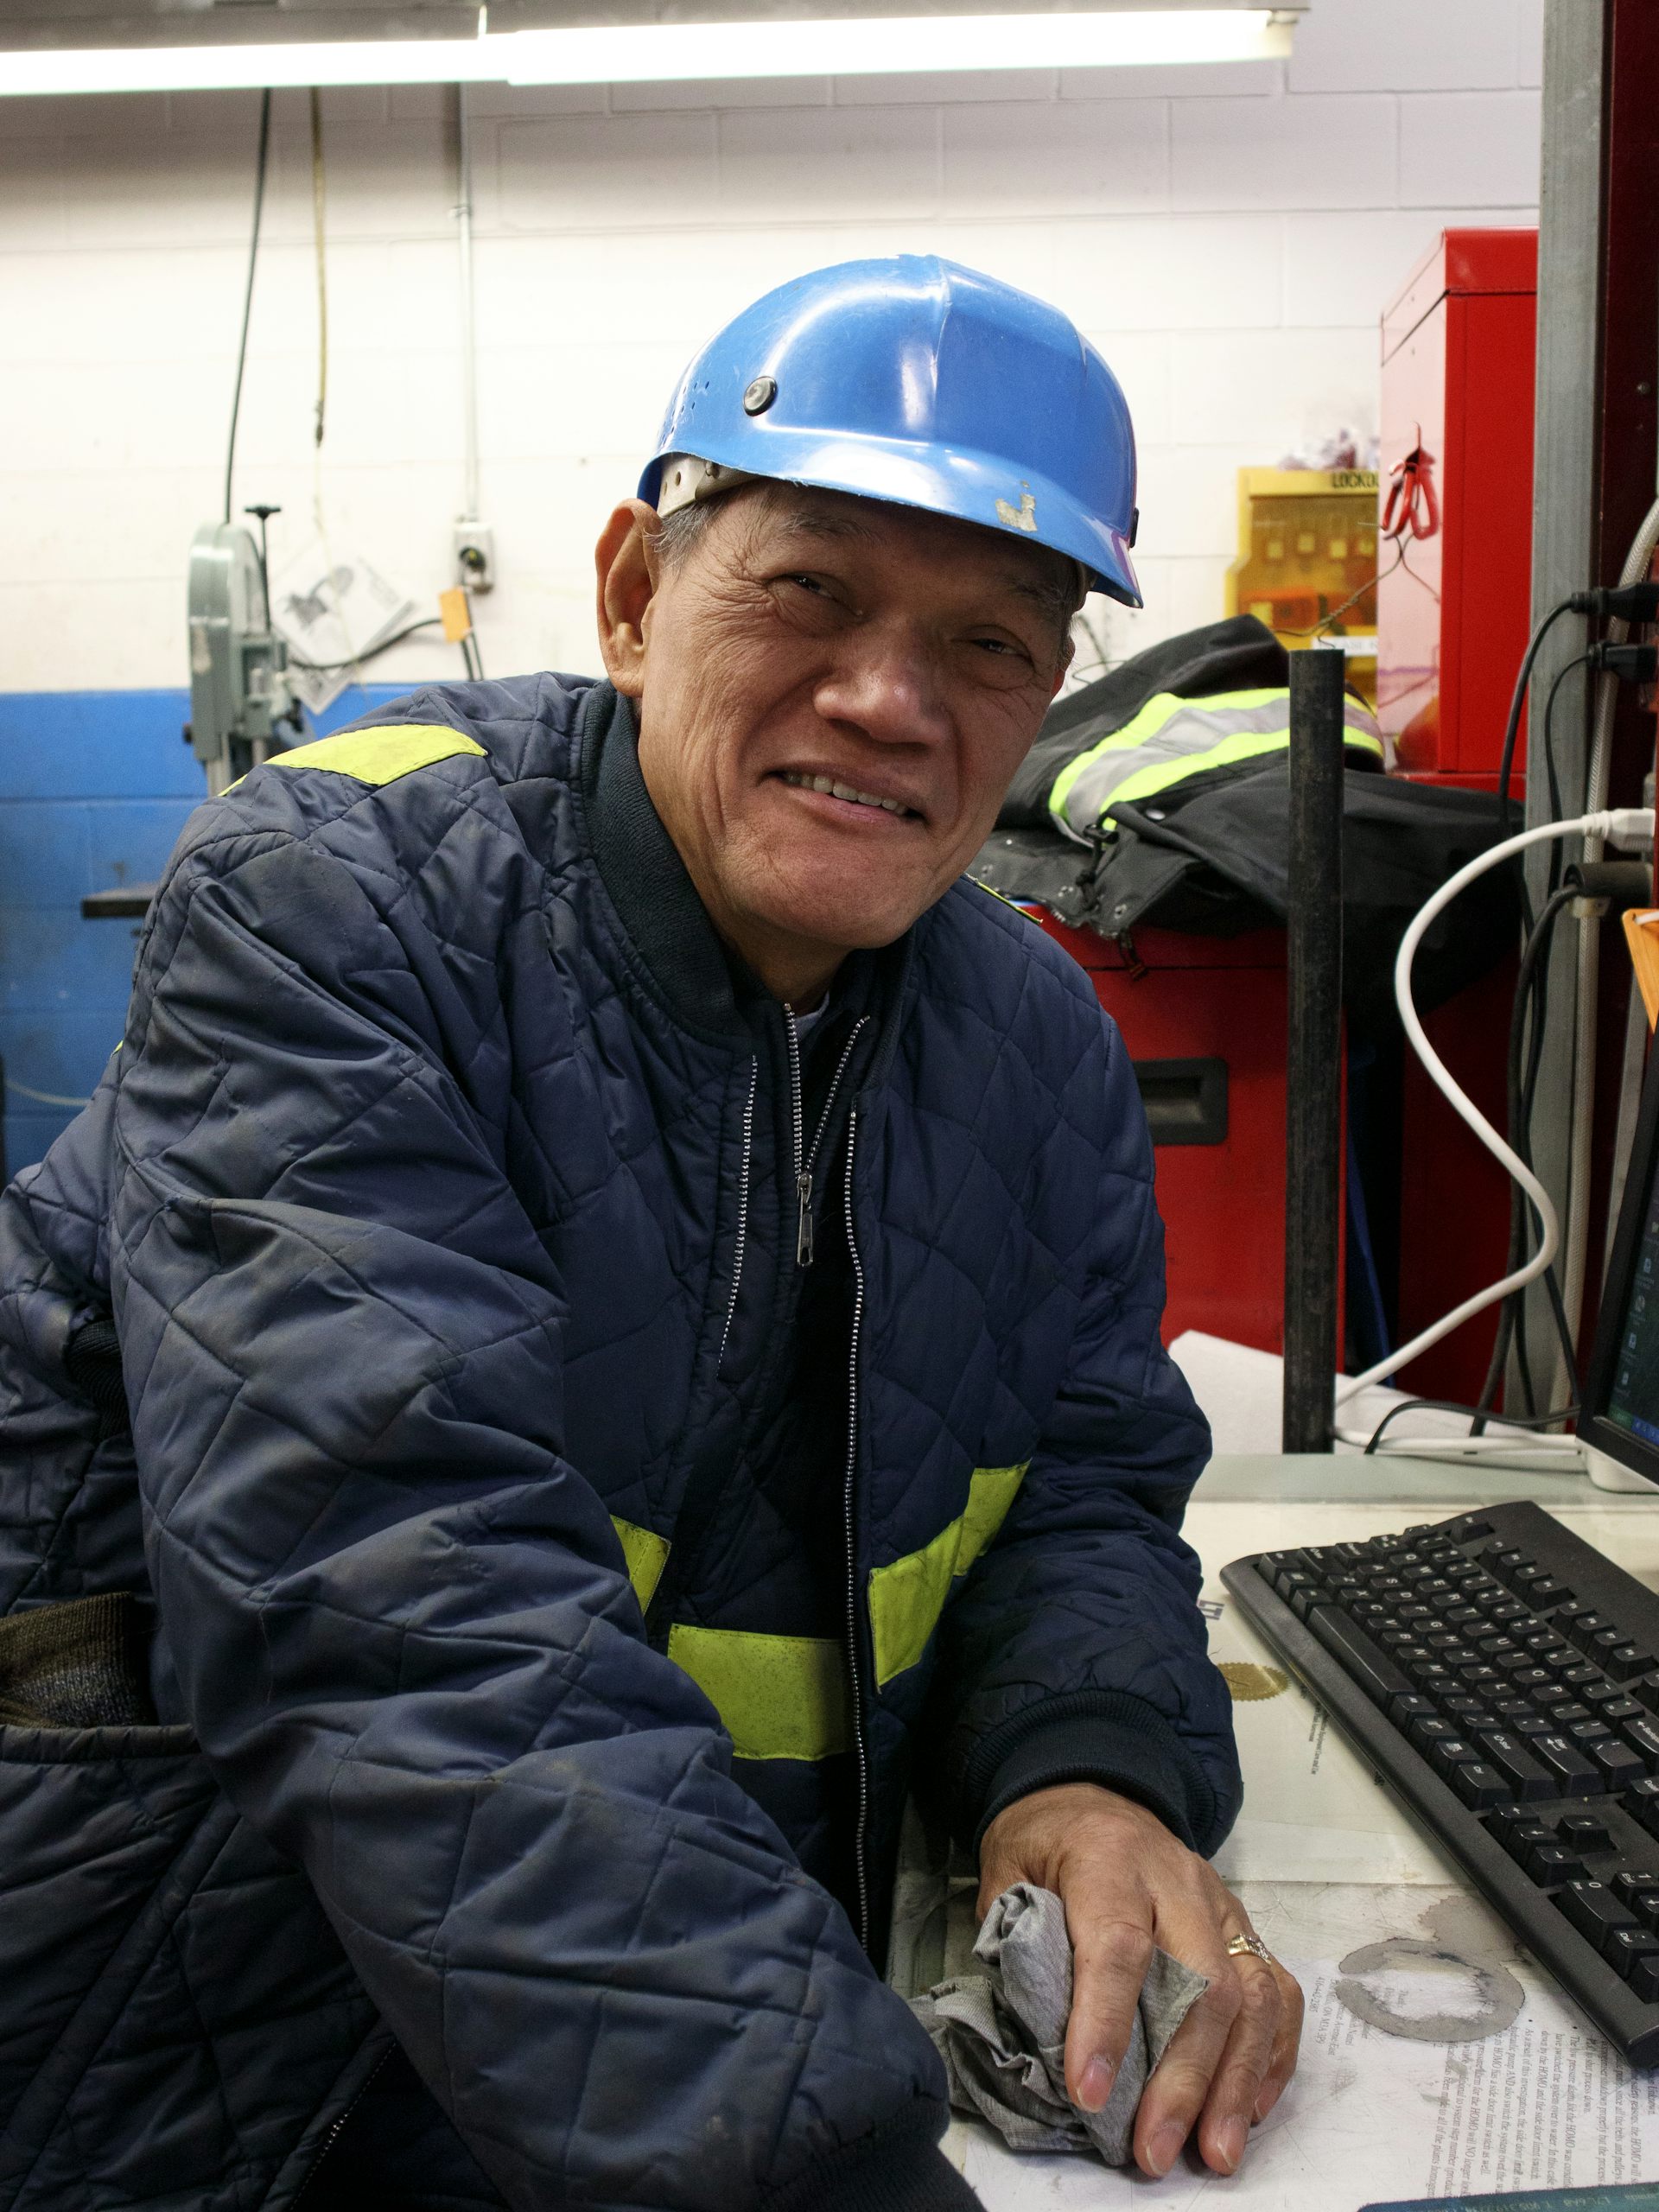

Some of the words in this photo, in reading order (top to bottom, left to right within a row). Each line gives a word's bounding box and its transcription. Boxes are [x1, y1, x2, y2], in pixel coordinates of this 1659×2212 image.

[1554, 1738, 1567, 1749] Enter
[1622, 1873, 1635, 1883] End
[1619, 1933, 1631, 1942] Del
[1323, 2007, 1333, 2016] ON
[1541, 2031, 1551, 2046] down
[1555, 2034, 1565, 2046] have
[1571, 2036, 1580, 2046] The
[1328, 2042, 1339, 2055] East
[1524, 2042, 1533, 2058] result
[1476, 2045, 1485, 2067] pressure
[1492, 2048, 1503, 2068] HOMO
[1504, 2052, 1515, 2069] pump
[1540, 2056, 1548, 2065] the
[1554, 2047, 1564, 2073] switched
[1522, 2066, 1532, 2077] this
[1567, 2059, 1576, 2083] pressure
[1585, 2060, 1595, 2071] shut
[1491, 2069, 1501, 2078] has
[1506, 2070, 1516, 2086] AND
[1537, 2066, 1548, 2088] HOMO
[1553, 2074, 1562, 2082] the
[1443, 2076, 1452, 2090] been
[1583, 2072, 1592, 2094] process
[1630, 2082, 1641, 2098] safety
[1473, 2087, 1483, 2096] for
[1489, 2085, 1500, 2097] side
[1504, 2086, 1514, 2099] also
[1517, 2078, 1528, 2116] investigation,
[1537, 2089, 1546, 2099] and
[1551, 2084, 1560, 2105] system
[1616, 2091, 1624, 2105] since
[1471, 2096, 1482, 2106] the
[1488, 2098, 1498, 2112] door
[1536, 2101, 1546, 2111] the
[1584, 2095, 1594, 2114] down.
[1648, 2086, 1658, 2115] Unknown.
[1452, 2105, 1462, 2126] system
[1502, 2101, 1512, 2120] switch
[1535, 2111, 1545, 2124] side
[1567, 2113, 1576, 2122] the
[1616, 2107, 1625, 2115] all
[1438, 2117, 1448, 2125] all
[1468, 2108, 1480, 2131] HOMO
[1486, 2113, 1496, 2128] limit
[1502, 2121, 1511, 2130] the
[1517, 2118, 1527, 2128] the
[1597, 2107, 1608, 2133] properly
[1616, 2116, 1625, 2125] the
[1449, 2128, 1460, 2141] step
[1467, 2132, 1476, 2144] will
[1516, 2129, 1527, 2143] side
[1534, 2125, 1544, 2140] door
[1565, 2124, 1576, 2148] HOMO
[1615, 2127, 1625, 2142] belts
[1631, 2126, 1640, 2136] the
[1435, 2134, 1445, 2143] the
[1483, 2130, 1493, 2150] switch
[1497, 2133, 1507, 2154] system
[1599, 2135, 1608, 2144] but
[1432, 2144, 1443, 2164] plants
[1448, 2142, 1458, 2166] number
[1465, 2146, 1476, 2157] NO
[1516, 2143, 1526, 2158] door
[1533, 2141, 1543, 2157] limit
[1599, 2146, 1609, 2156] the
[1615, 2143, 1625, 2155] and
[1631, 2138, 1641, 2162] HOMO
[1461, 2158, 1473, 2179] longer
[1548, 2157, 1558, 2169] this
[1595, 2157, 1606, 2182] process
[1612, 2156, 1625, 2179] pulleys
[1497, 2171, 1506, 2181] the
[1564, 2163, 1574, 2188] conditi
[1631, 2164, 1641, 2177] will
[1426, 2165, 1441, 2199] homogen
[1444, 2168, 1455, 2197] (product
